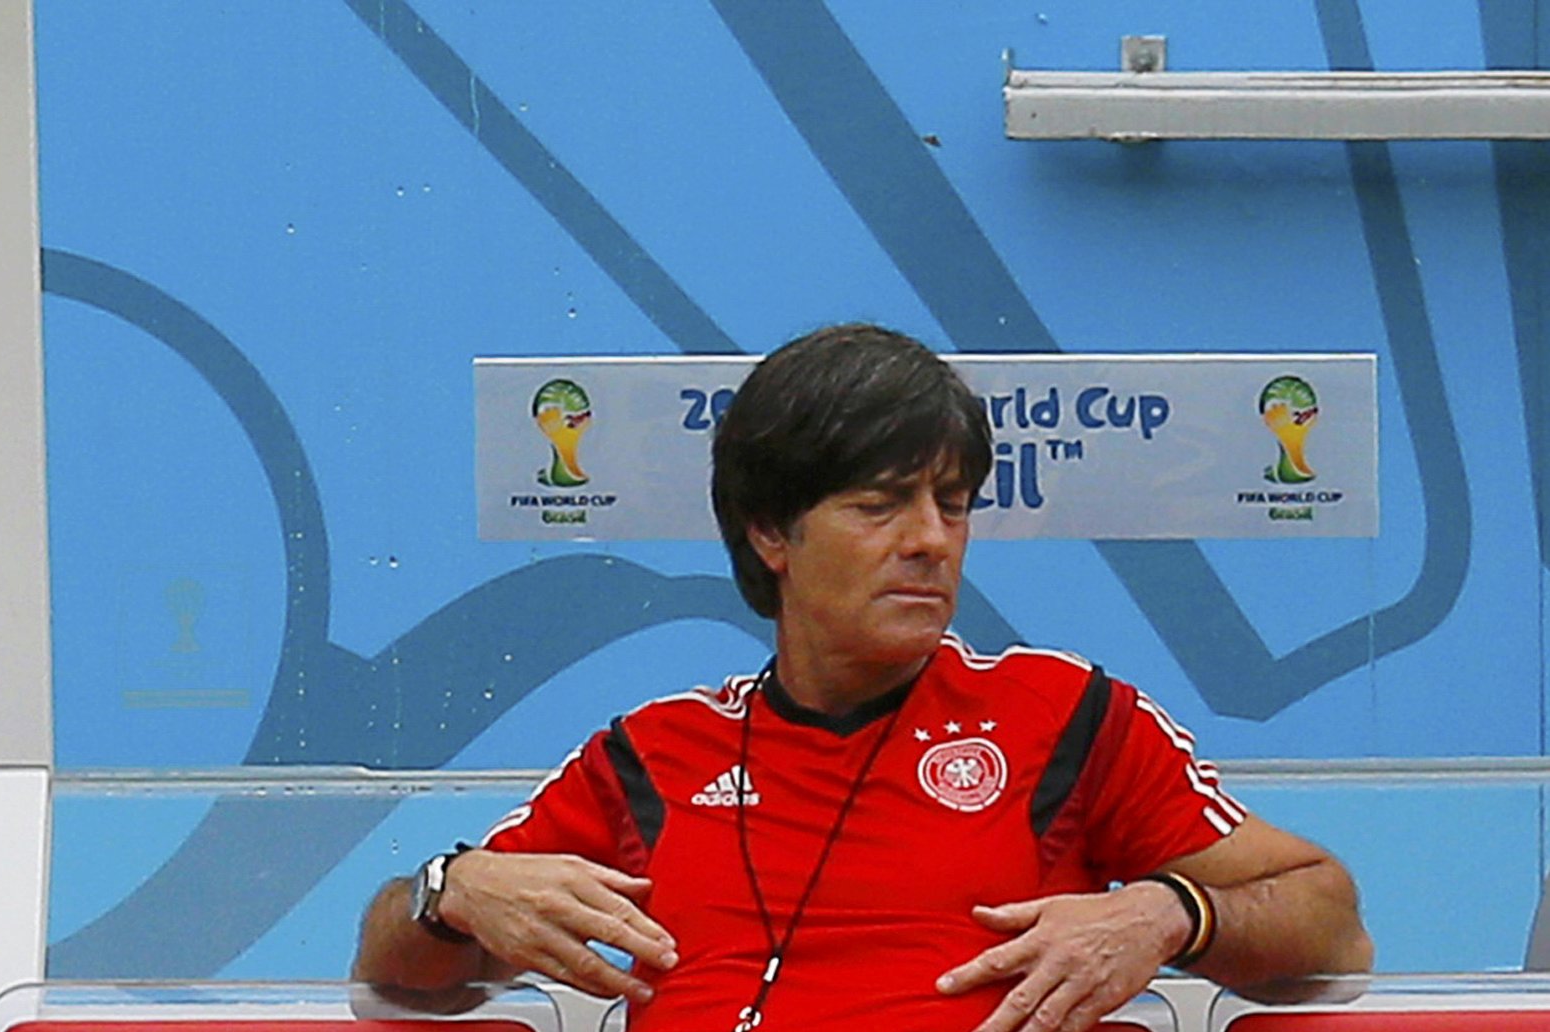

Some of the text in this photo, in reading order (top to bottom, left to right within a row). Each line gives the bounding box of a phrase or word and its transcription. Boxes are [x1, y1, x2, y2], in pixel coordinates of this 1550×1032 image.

[1075, 386, 1171, 440] Cup
[541, 495, 589, 507] WORLD
[590, 494, 618, 507] CUP
[1267, 492, 1315, 504] WORLD
